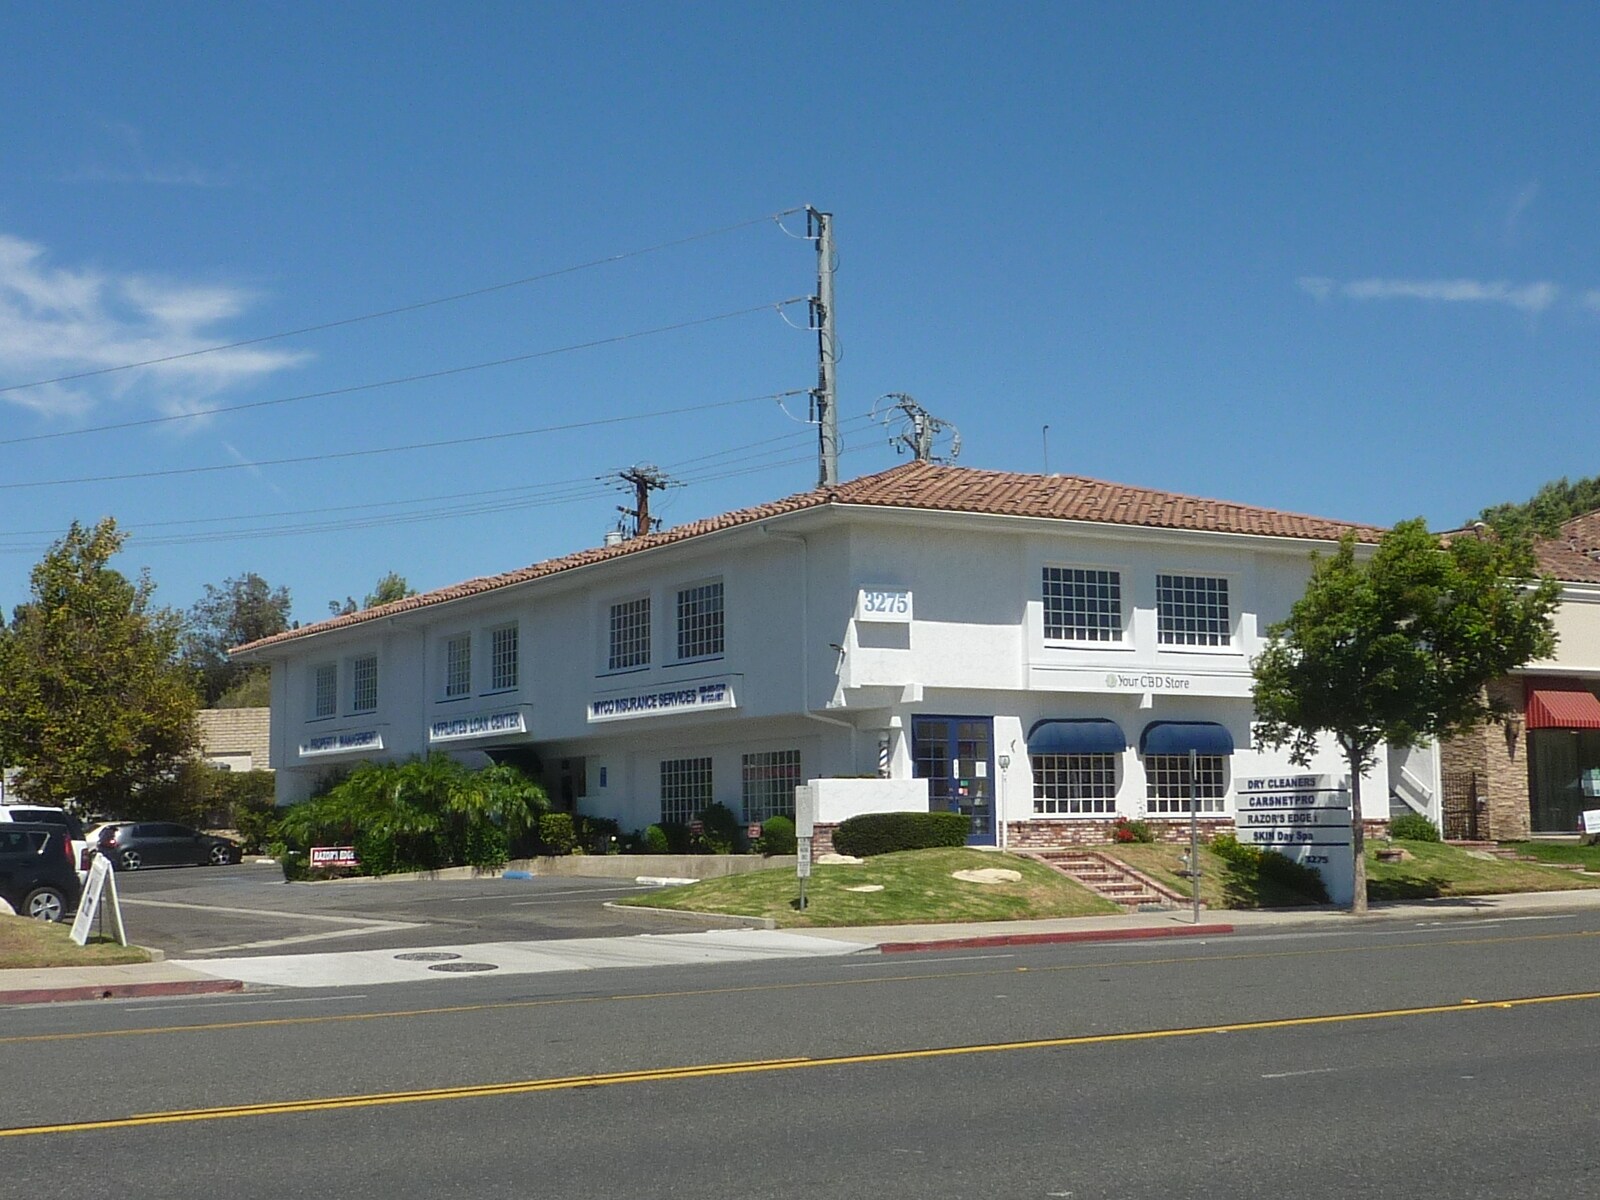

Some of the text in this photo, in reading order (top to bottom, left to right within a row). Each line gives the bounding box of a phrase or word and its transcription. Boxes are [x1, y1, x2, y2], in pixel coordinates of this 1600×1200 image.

[864, 592, 908, 613] 3275
[1117, 674, 1190, 689] Your CBD Store
[593, 700, 614, 715] MYCO
[614, 693, 657, 714] INSURANCE
[658, 689, 698, 707] SERVICES
[470, 716, 488, 733] LOAN
[491, 711, 520, 730] CENTER
[1247, 777, 1316, 789] DRY CLEANERS
[1248, 795, 1315, 807] CARSNETPRO
[1247, 814, 1285, 824] RAZOR'S
[1287, 813, 1312, 823] EDGE
[1253, 831, 1314, 842] SKIN Day Spa
